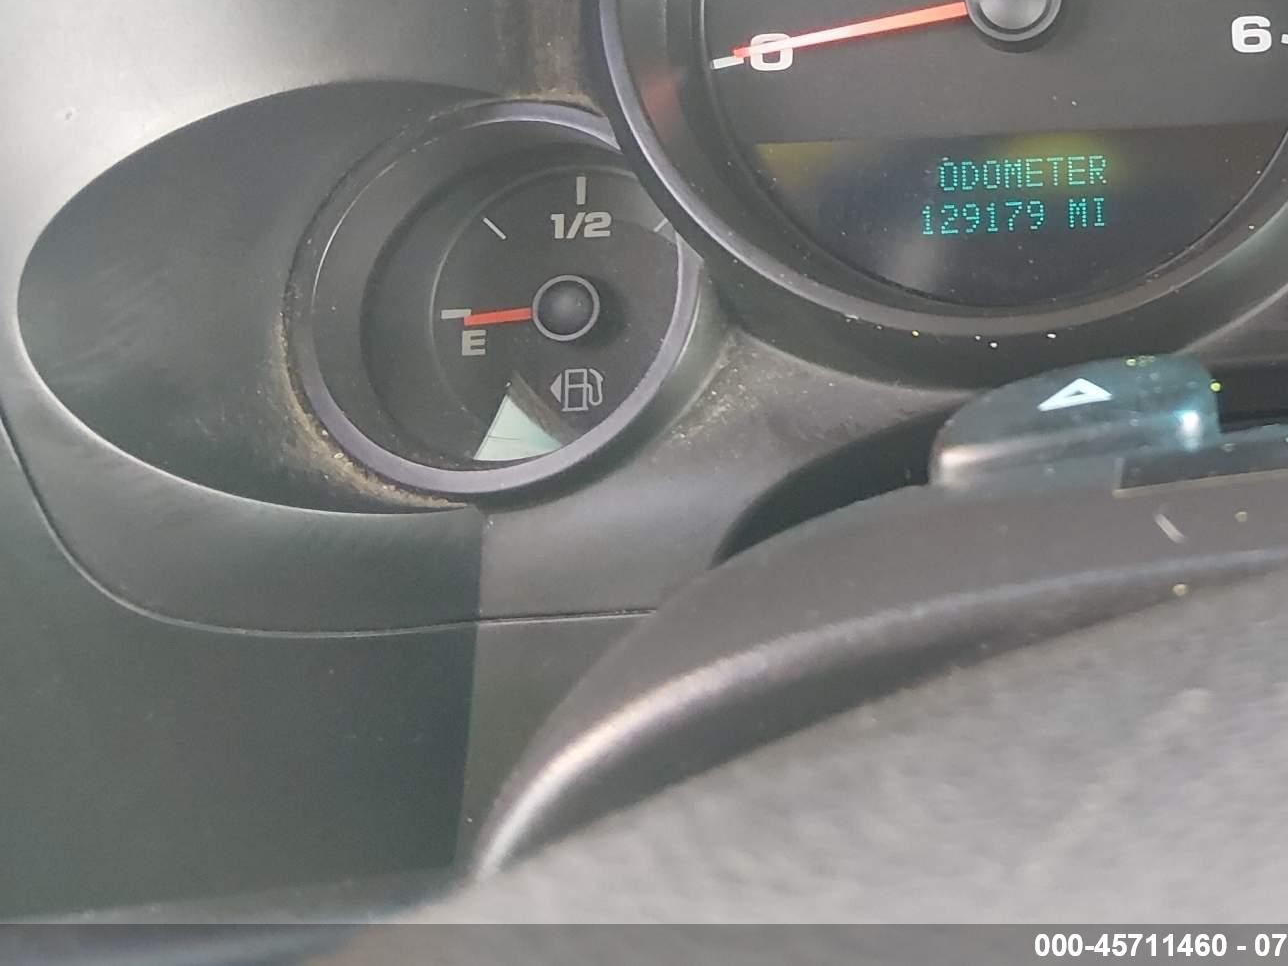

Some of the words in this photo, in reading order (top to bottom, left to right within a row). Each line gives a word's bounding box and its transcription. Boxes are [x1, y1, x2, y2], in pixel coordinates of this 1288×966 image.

[750, 33, 794, 71] 0
[1231, 15, 1272, 53] 6
[939, 155, 1107, 191] ODOMETER
[550, 211, 612, 239] 1/2
[922, 200, 1044, 235] 129179
[1069, 197, 1105, 228] MI
[461, 329, 487, 356] E
